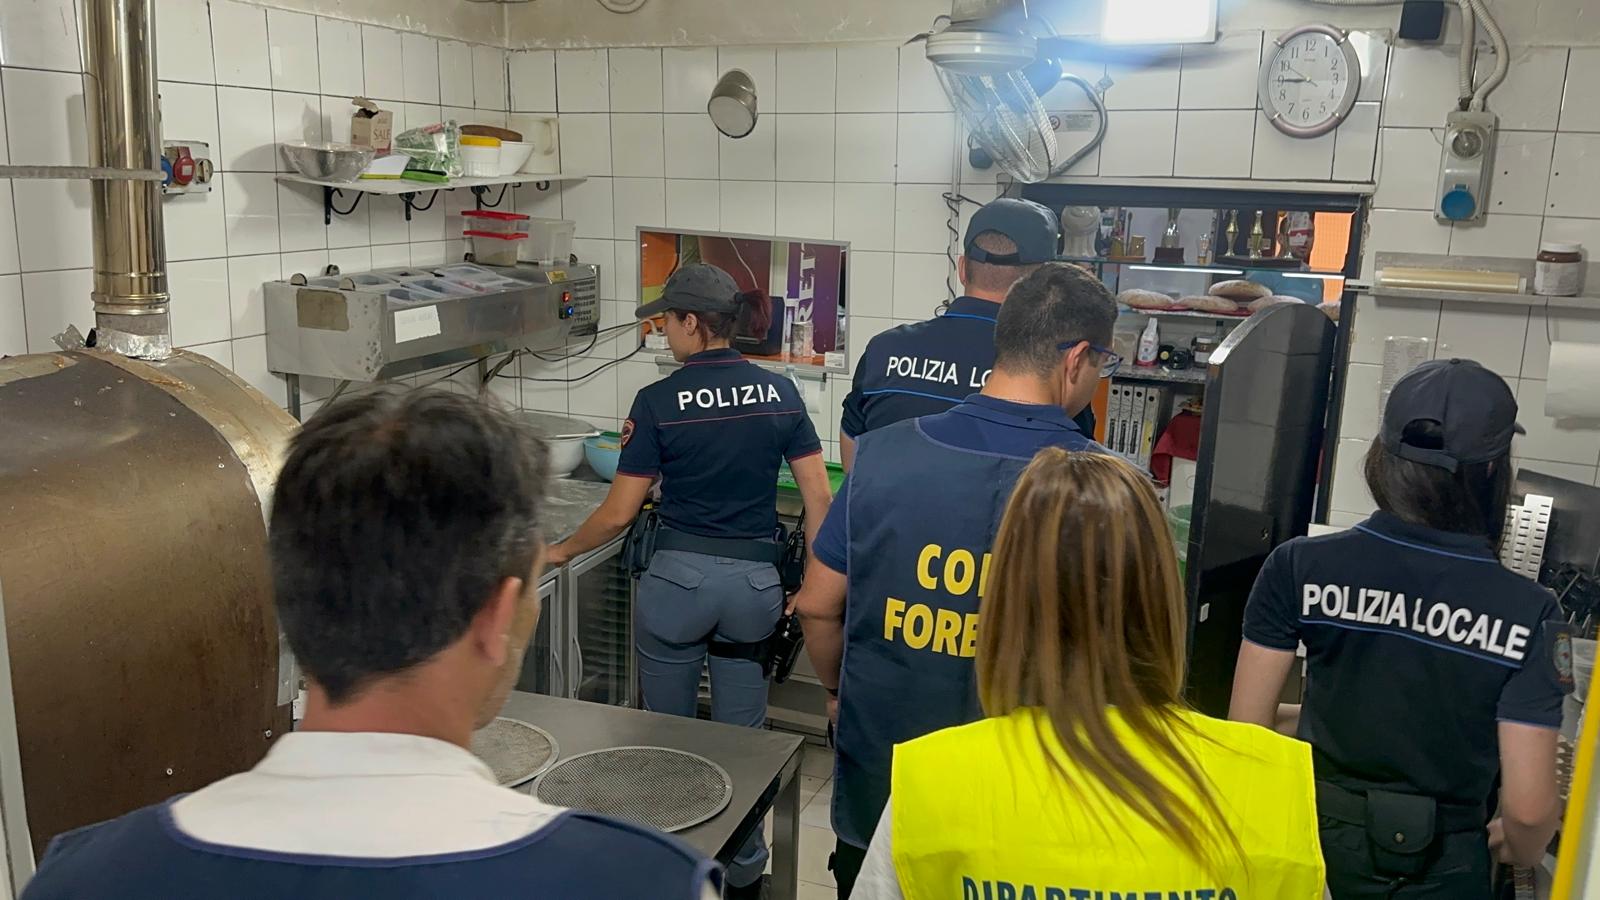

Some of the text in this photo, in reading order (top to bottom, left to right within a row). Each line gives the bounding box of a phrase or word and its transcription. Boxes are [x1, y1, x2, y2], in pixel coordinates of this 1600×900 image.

[1305, 39, 1317, 52] 12
[1324, 45, 1329, 57] 1
[1291, 47, 1299, 59] 11
[1280, 60, 1290, 72] 10
[1331, 59, 1338, 71] 2
[1332, 72, 1339, 85] 3
[1279, 89, 1286, 101] 8
[1328, 88, 1335, 100] 4
[1288, 103, 1295, 115] 7
[1302, 107, 1310, 120] 6
[1320, 101, 1327, 114] 5
[886, 356, 959, 385] POLIZIA
[677, 383, 782, 411] POLIZIA
[1302, 583, 1531, 661] POLIZIA LOCALE
